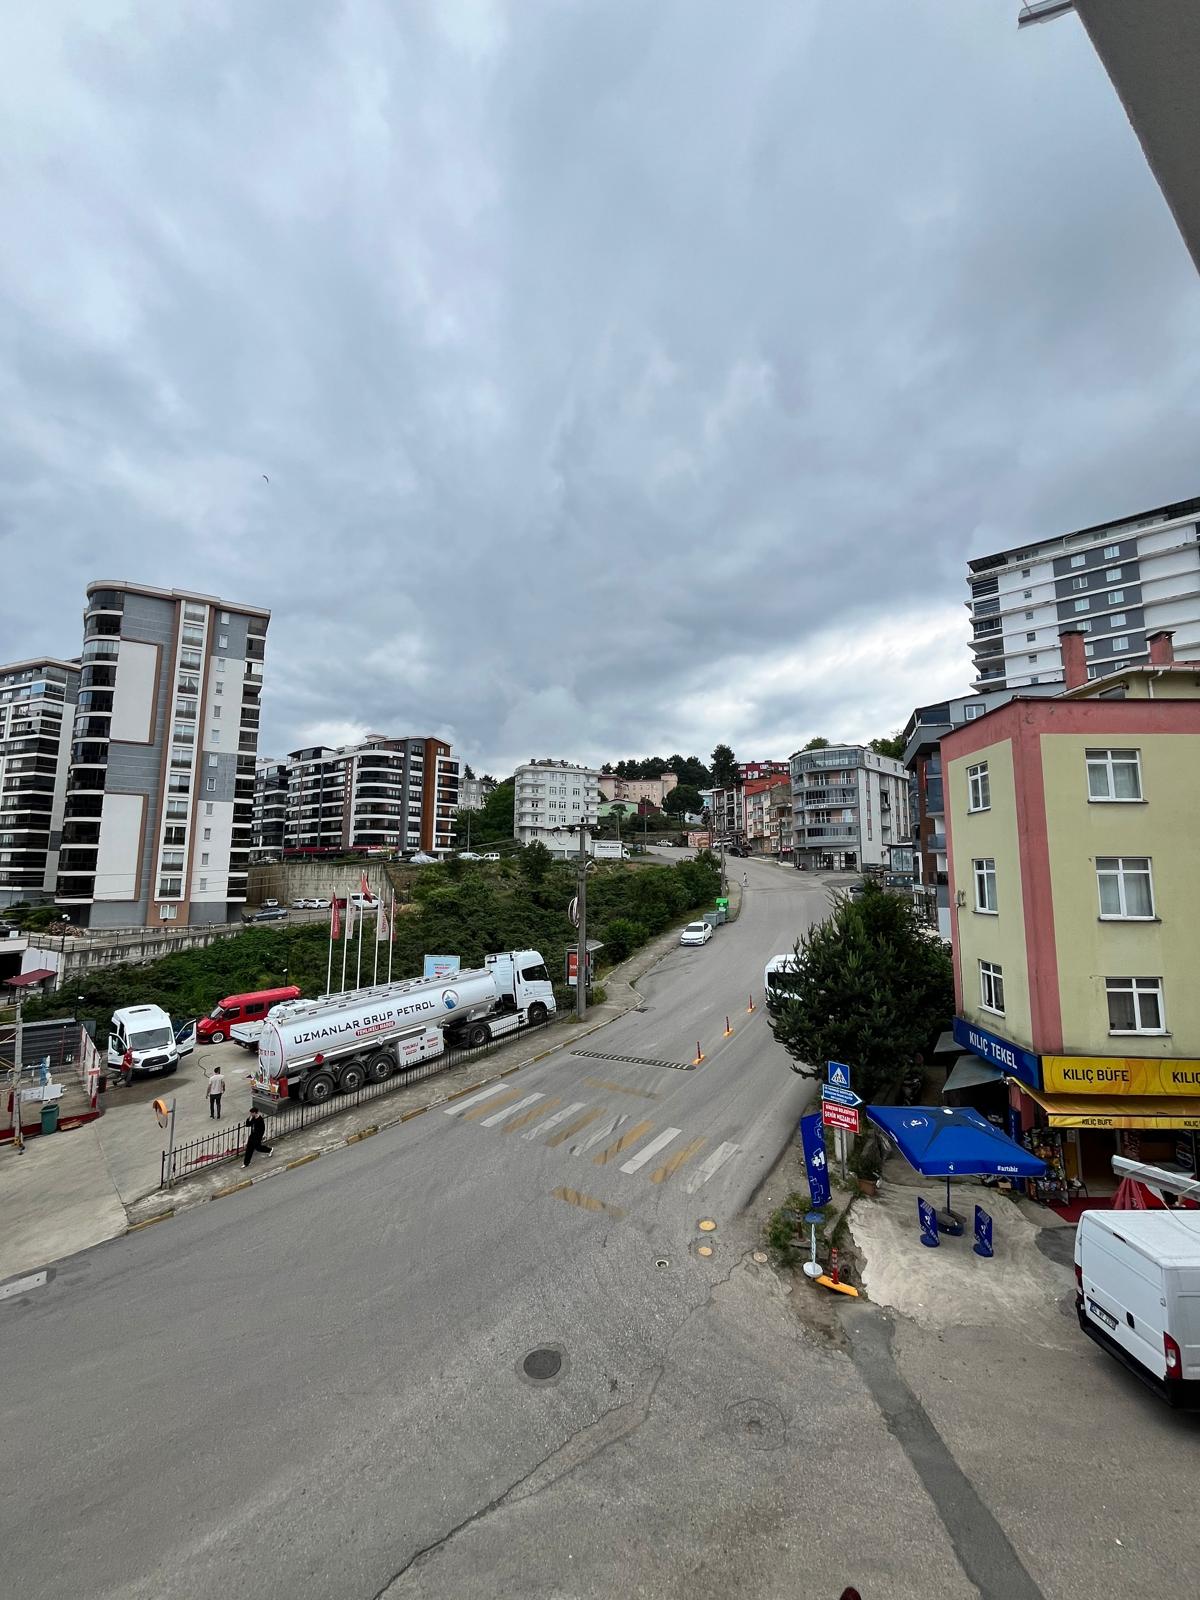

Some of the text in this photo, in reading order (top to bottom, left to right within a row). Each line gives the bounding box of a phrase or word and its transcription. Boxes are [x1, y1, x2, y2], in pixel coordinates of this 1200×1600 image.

[294, 1000, 436, 1044] UZMANLAR GRUP PETROL
[969, 1030, 1018, 1069] KILIÇ TEKEL
[1063, 1066, 1130, 1084] KILIÇ BÜFE
